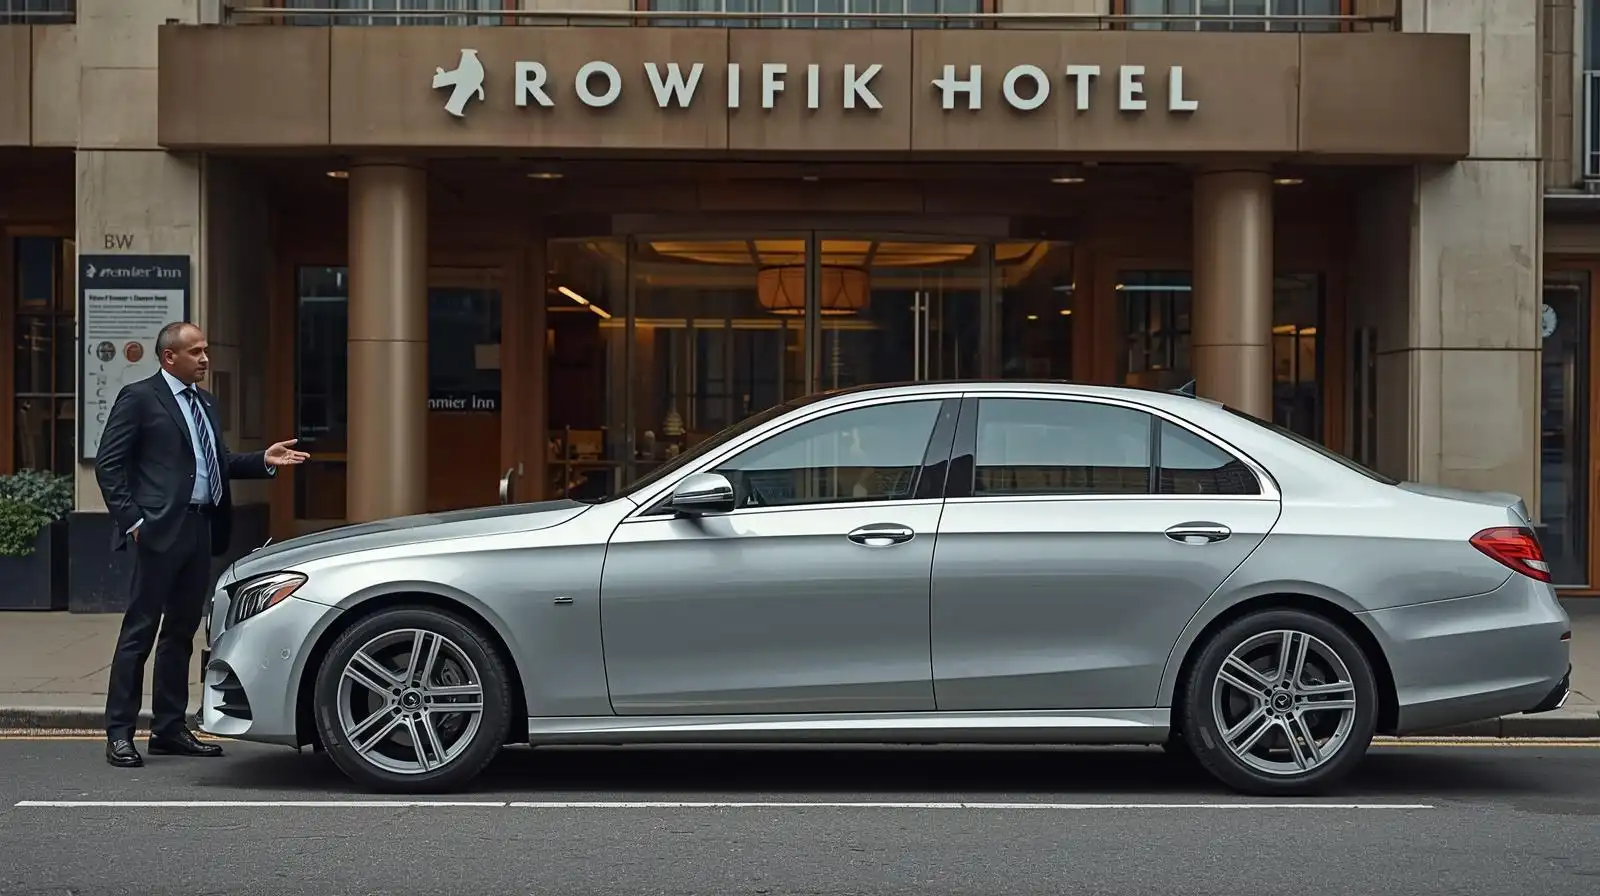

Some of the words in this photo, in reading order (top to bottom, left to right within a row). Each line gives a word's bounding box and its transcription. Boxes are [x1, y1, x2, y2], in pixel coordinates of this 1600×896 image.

[515, 61, 883, 109] ROWIFIK
[931, 64, 1199, 111] HOTEL
[104, 234, 134, 250] BW
